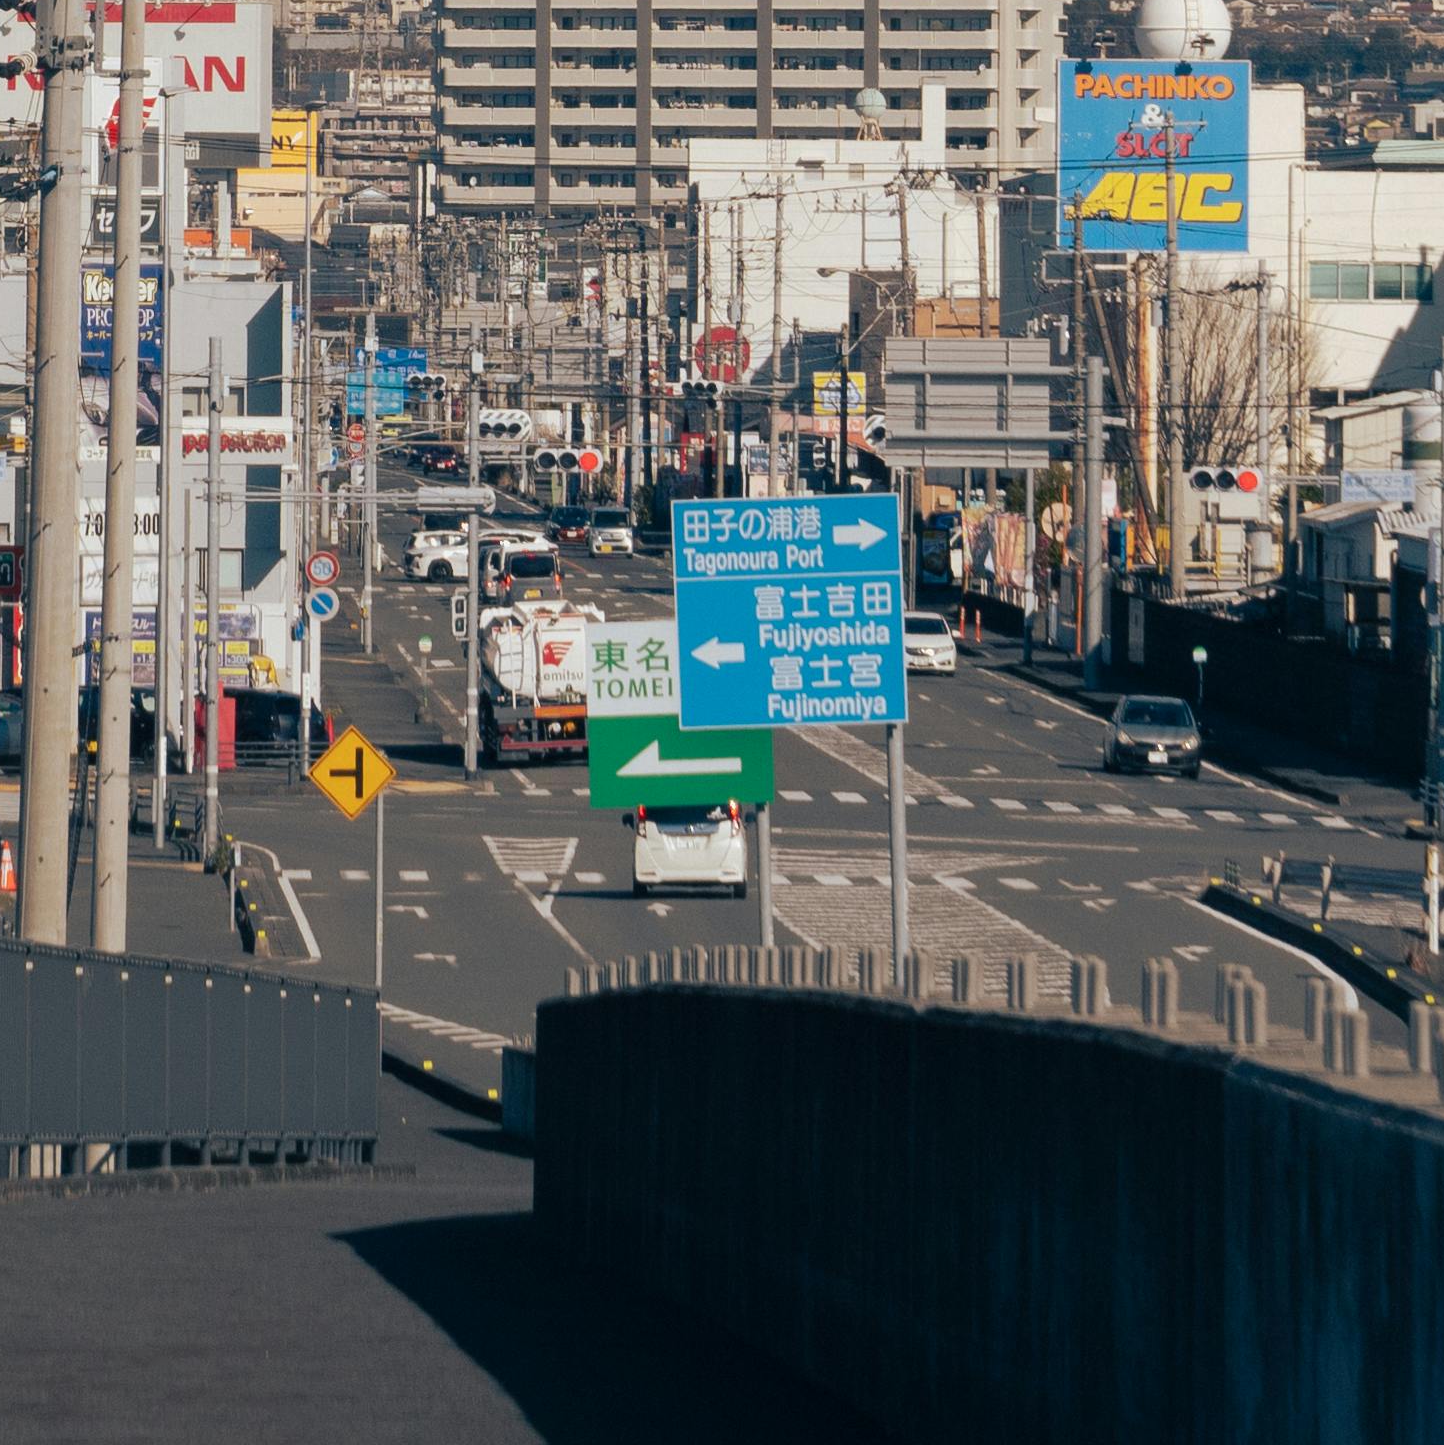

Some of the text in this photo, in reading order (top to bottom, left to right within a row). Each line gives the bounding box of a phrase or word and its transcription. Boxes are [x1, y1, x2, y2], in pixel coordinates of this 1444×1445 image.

[1075, 74, 1234, 100] PACHINKO
[1141, 104, 1164, 131] &
[1065, 172, 1243, 222] ABC
[683, 505, 822, 544] 田子の浦港
[683, 543, 824, 575] Tagonoura Port
[754, 581, 892, 621] 富士吉田
[759, 620, 891, 652] Fujiyoshida
[592, 637, 670, 673] 東名
[769, 652, 882, 691] 富士宮
[592, 677, 674, 699] TOMEI
[767, 691, 888, 722] Fujinomiya
